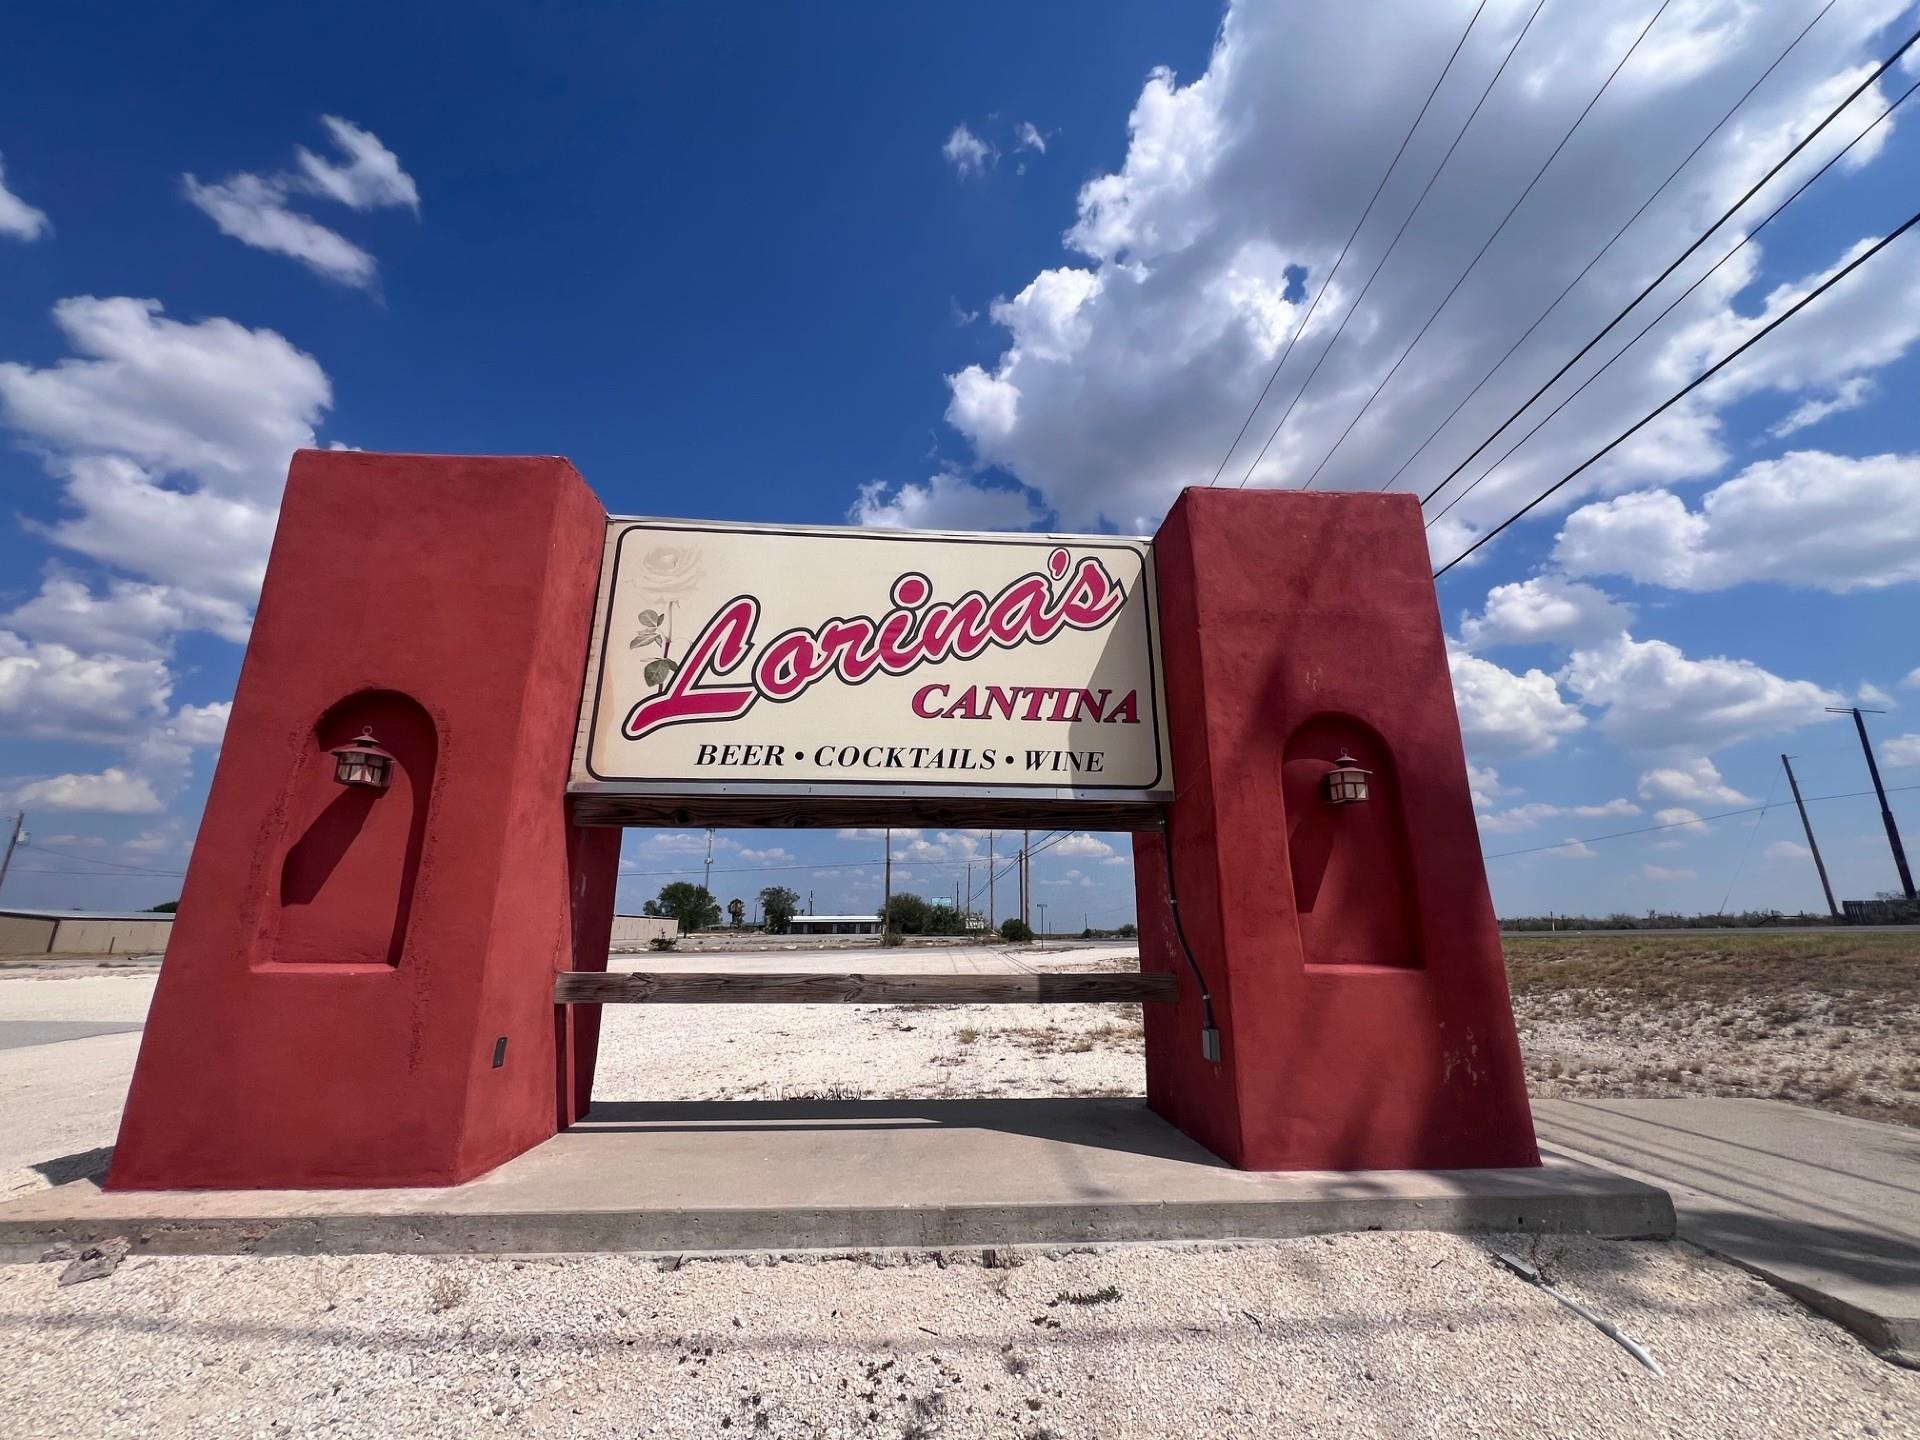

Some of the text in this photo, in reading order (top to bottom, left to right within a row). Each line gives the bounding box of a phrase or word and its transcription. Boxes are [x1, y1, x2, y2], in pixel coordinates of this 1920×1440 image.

[623, 546, 1126, 740] Lorina's
[912, 684, 1140, 724] CANTINA
[695, 744, 1105, 773] BEER COCKTAILS WINE
